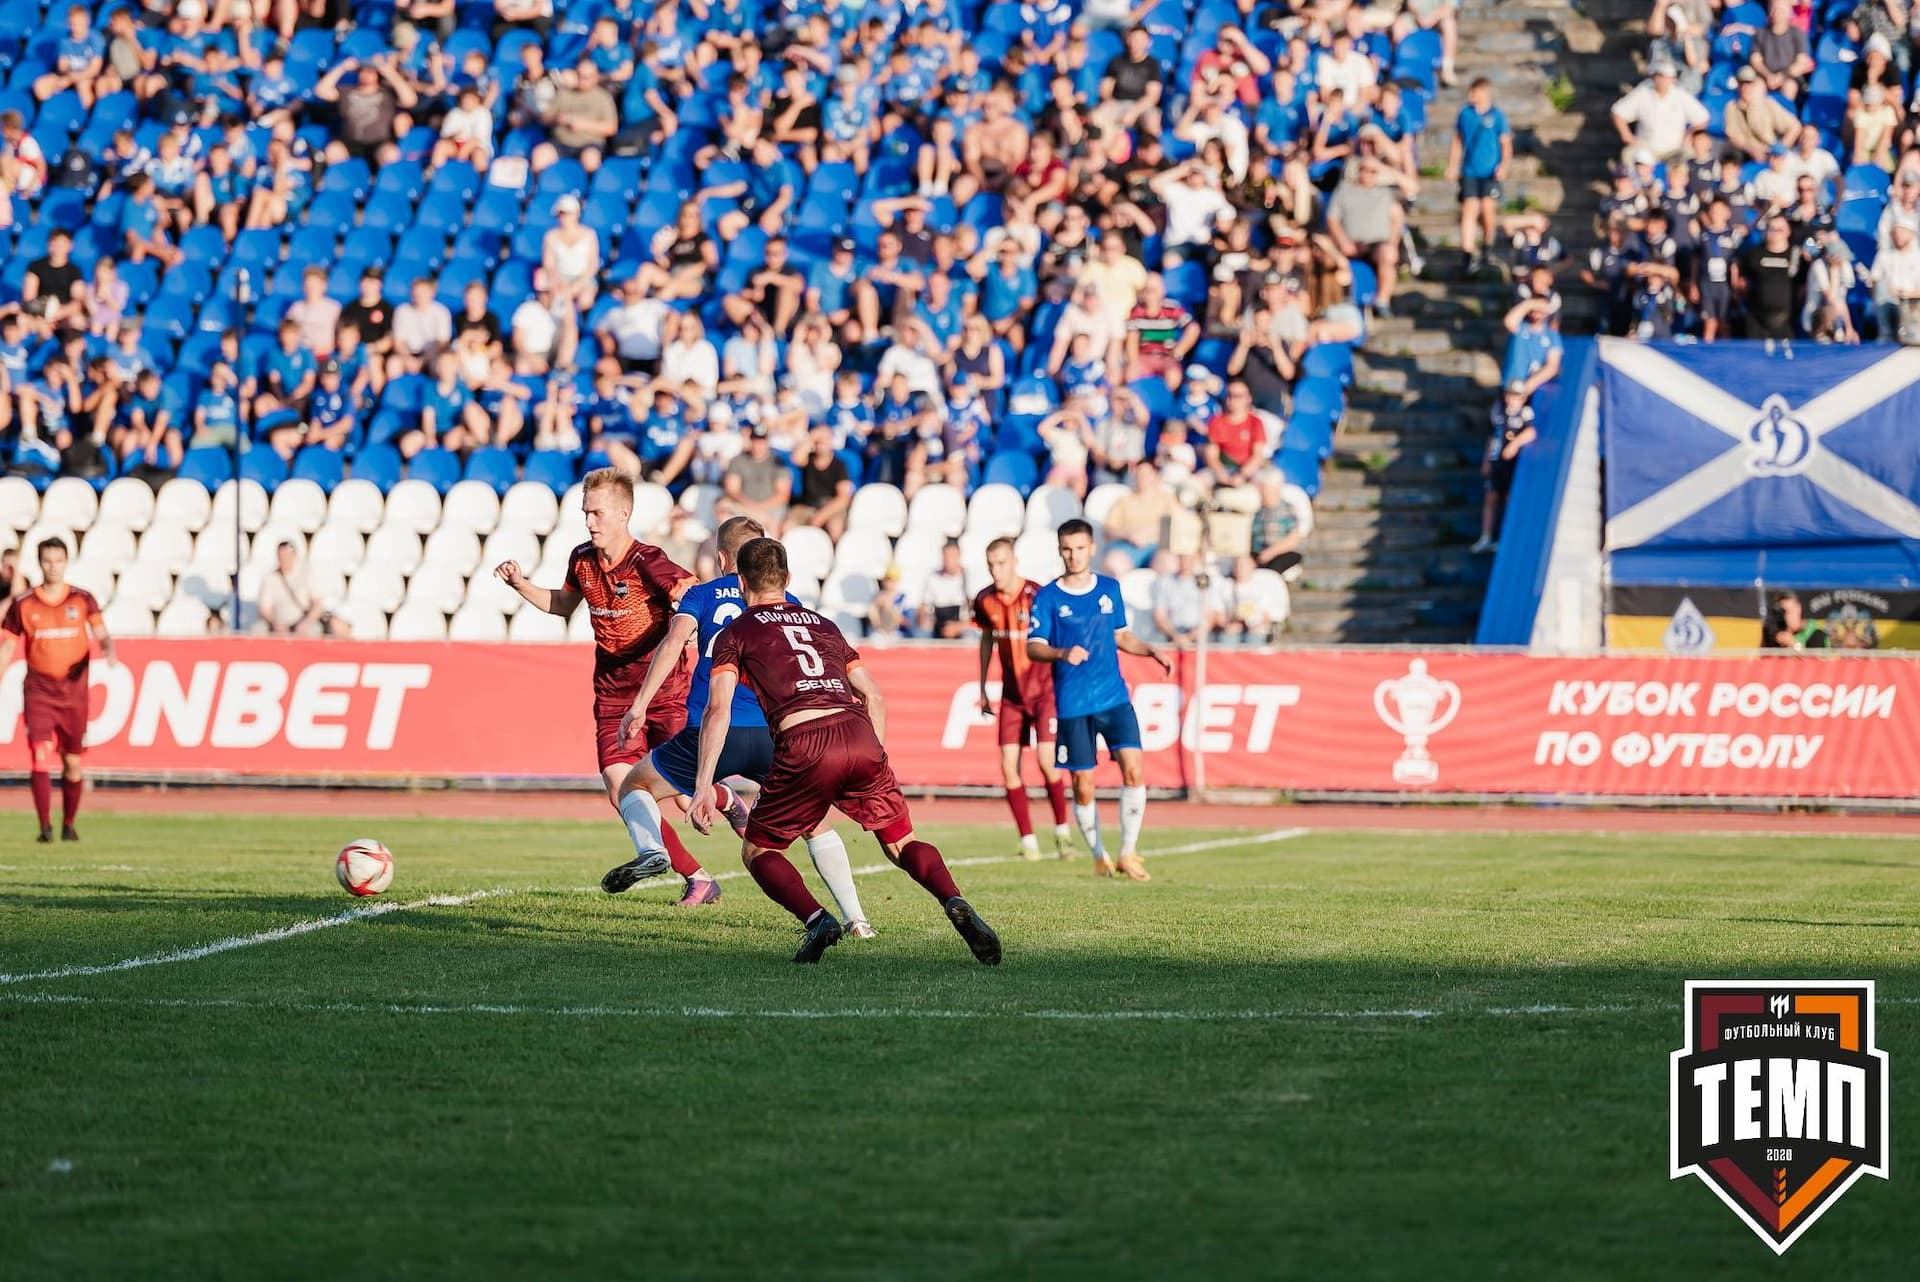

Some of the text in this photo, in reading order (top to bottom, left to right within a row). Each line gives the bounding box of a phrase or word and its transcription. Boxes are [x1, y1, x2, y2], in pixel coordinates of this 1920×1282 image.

[715, 587, 743, 599] ЗАВ
[753, 610, 821, 625] БОРИСОВ
[781, 625, 825, 677] 5
[795, 678, 844, 692] SEUS
[1548, 680, 1896, 719] КУБОК РОССИИ
[941, 681, 1300, 753] FBET
[1534, 731, 1824, 769] ПО ФУТБОЛУ
